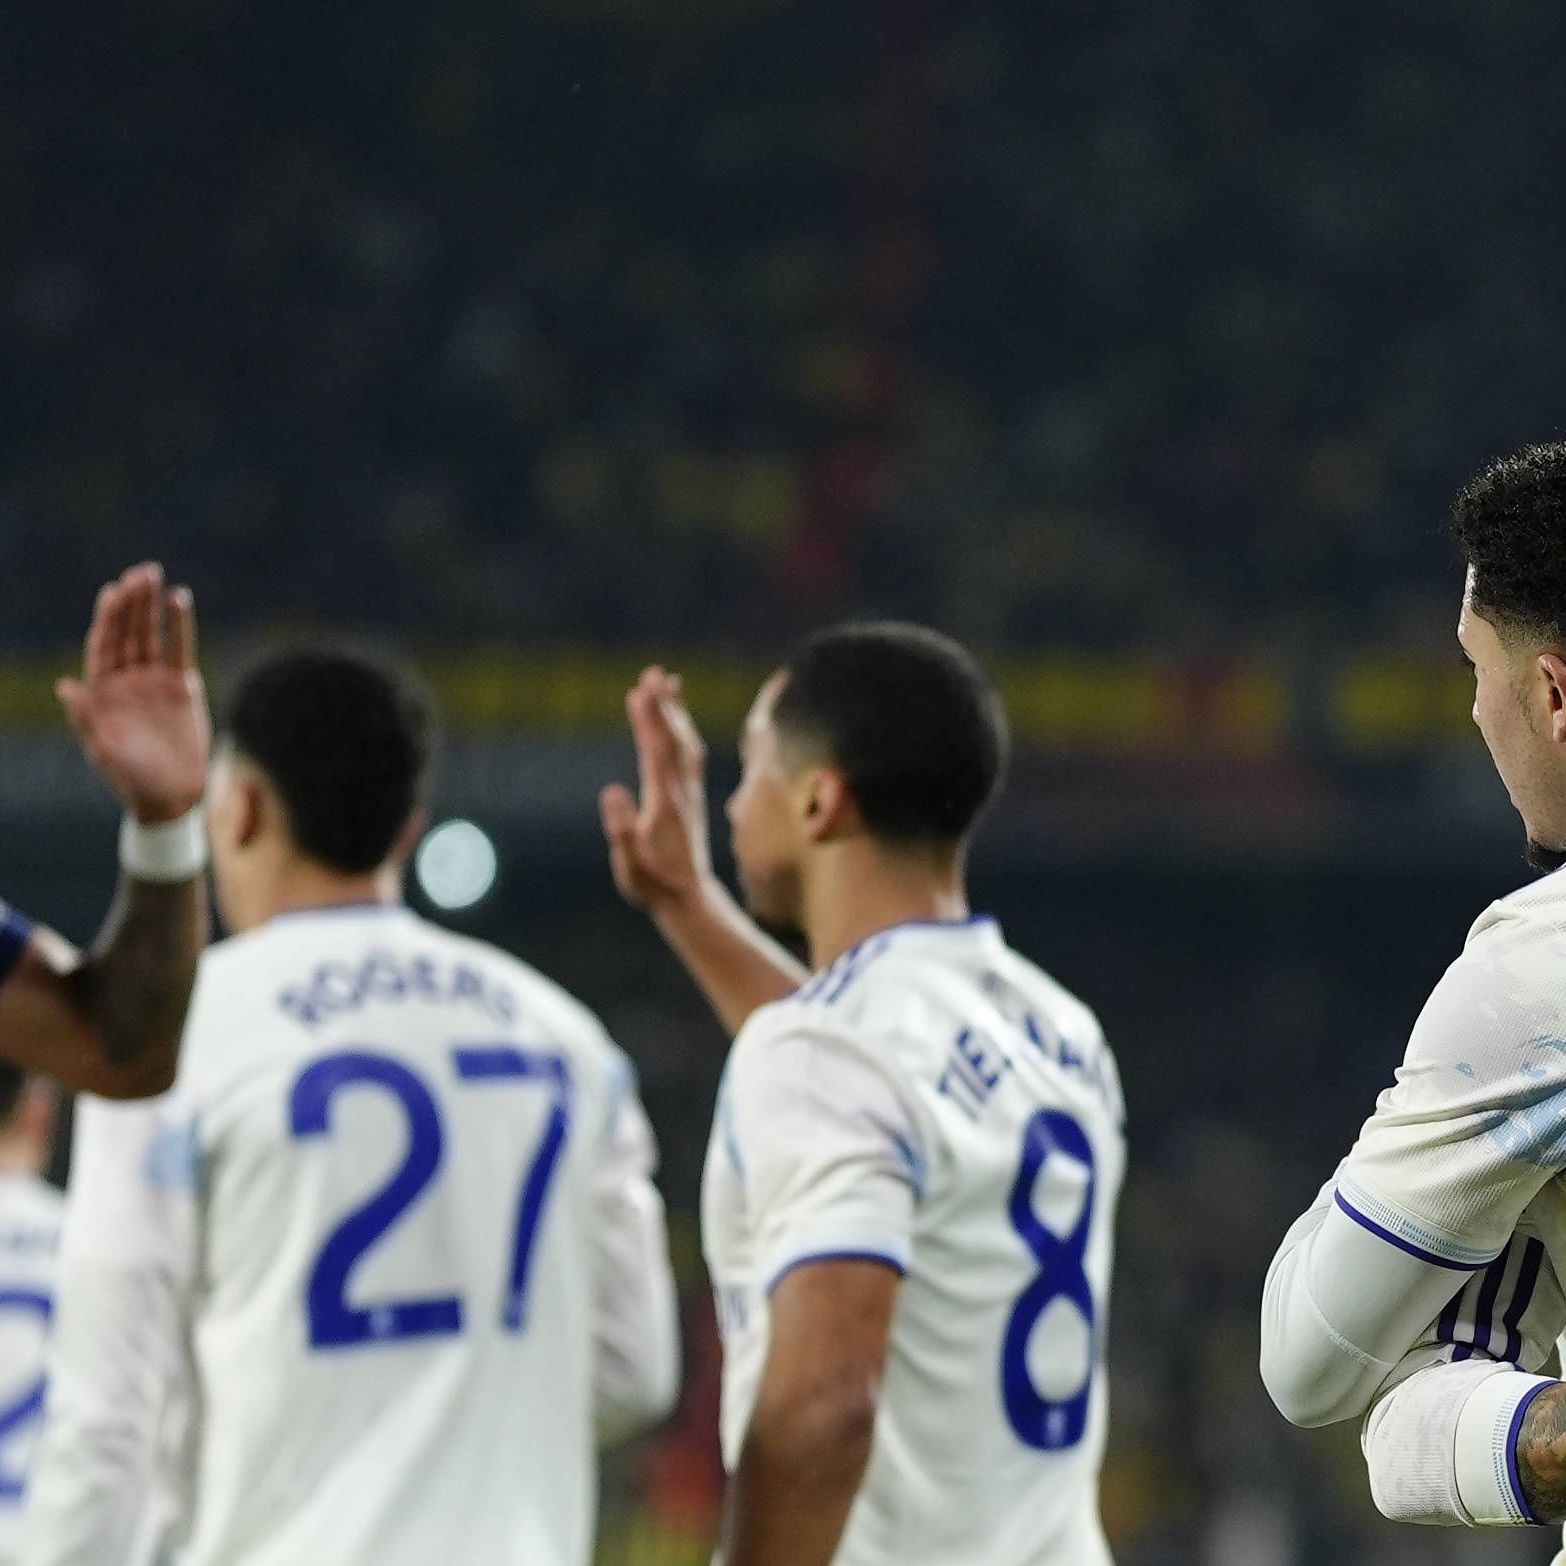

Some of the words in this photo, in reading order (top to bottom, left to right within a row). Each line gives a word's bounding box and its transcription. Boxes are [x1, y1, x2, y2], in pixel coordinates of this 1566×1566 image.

[278, 950, 518, 1026] ROGERS
[289, 1049, 573, 1348] 27
[999, 1107, 1101, 1454] 8
